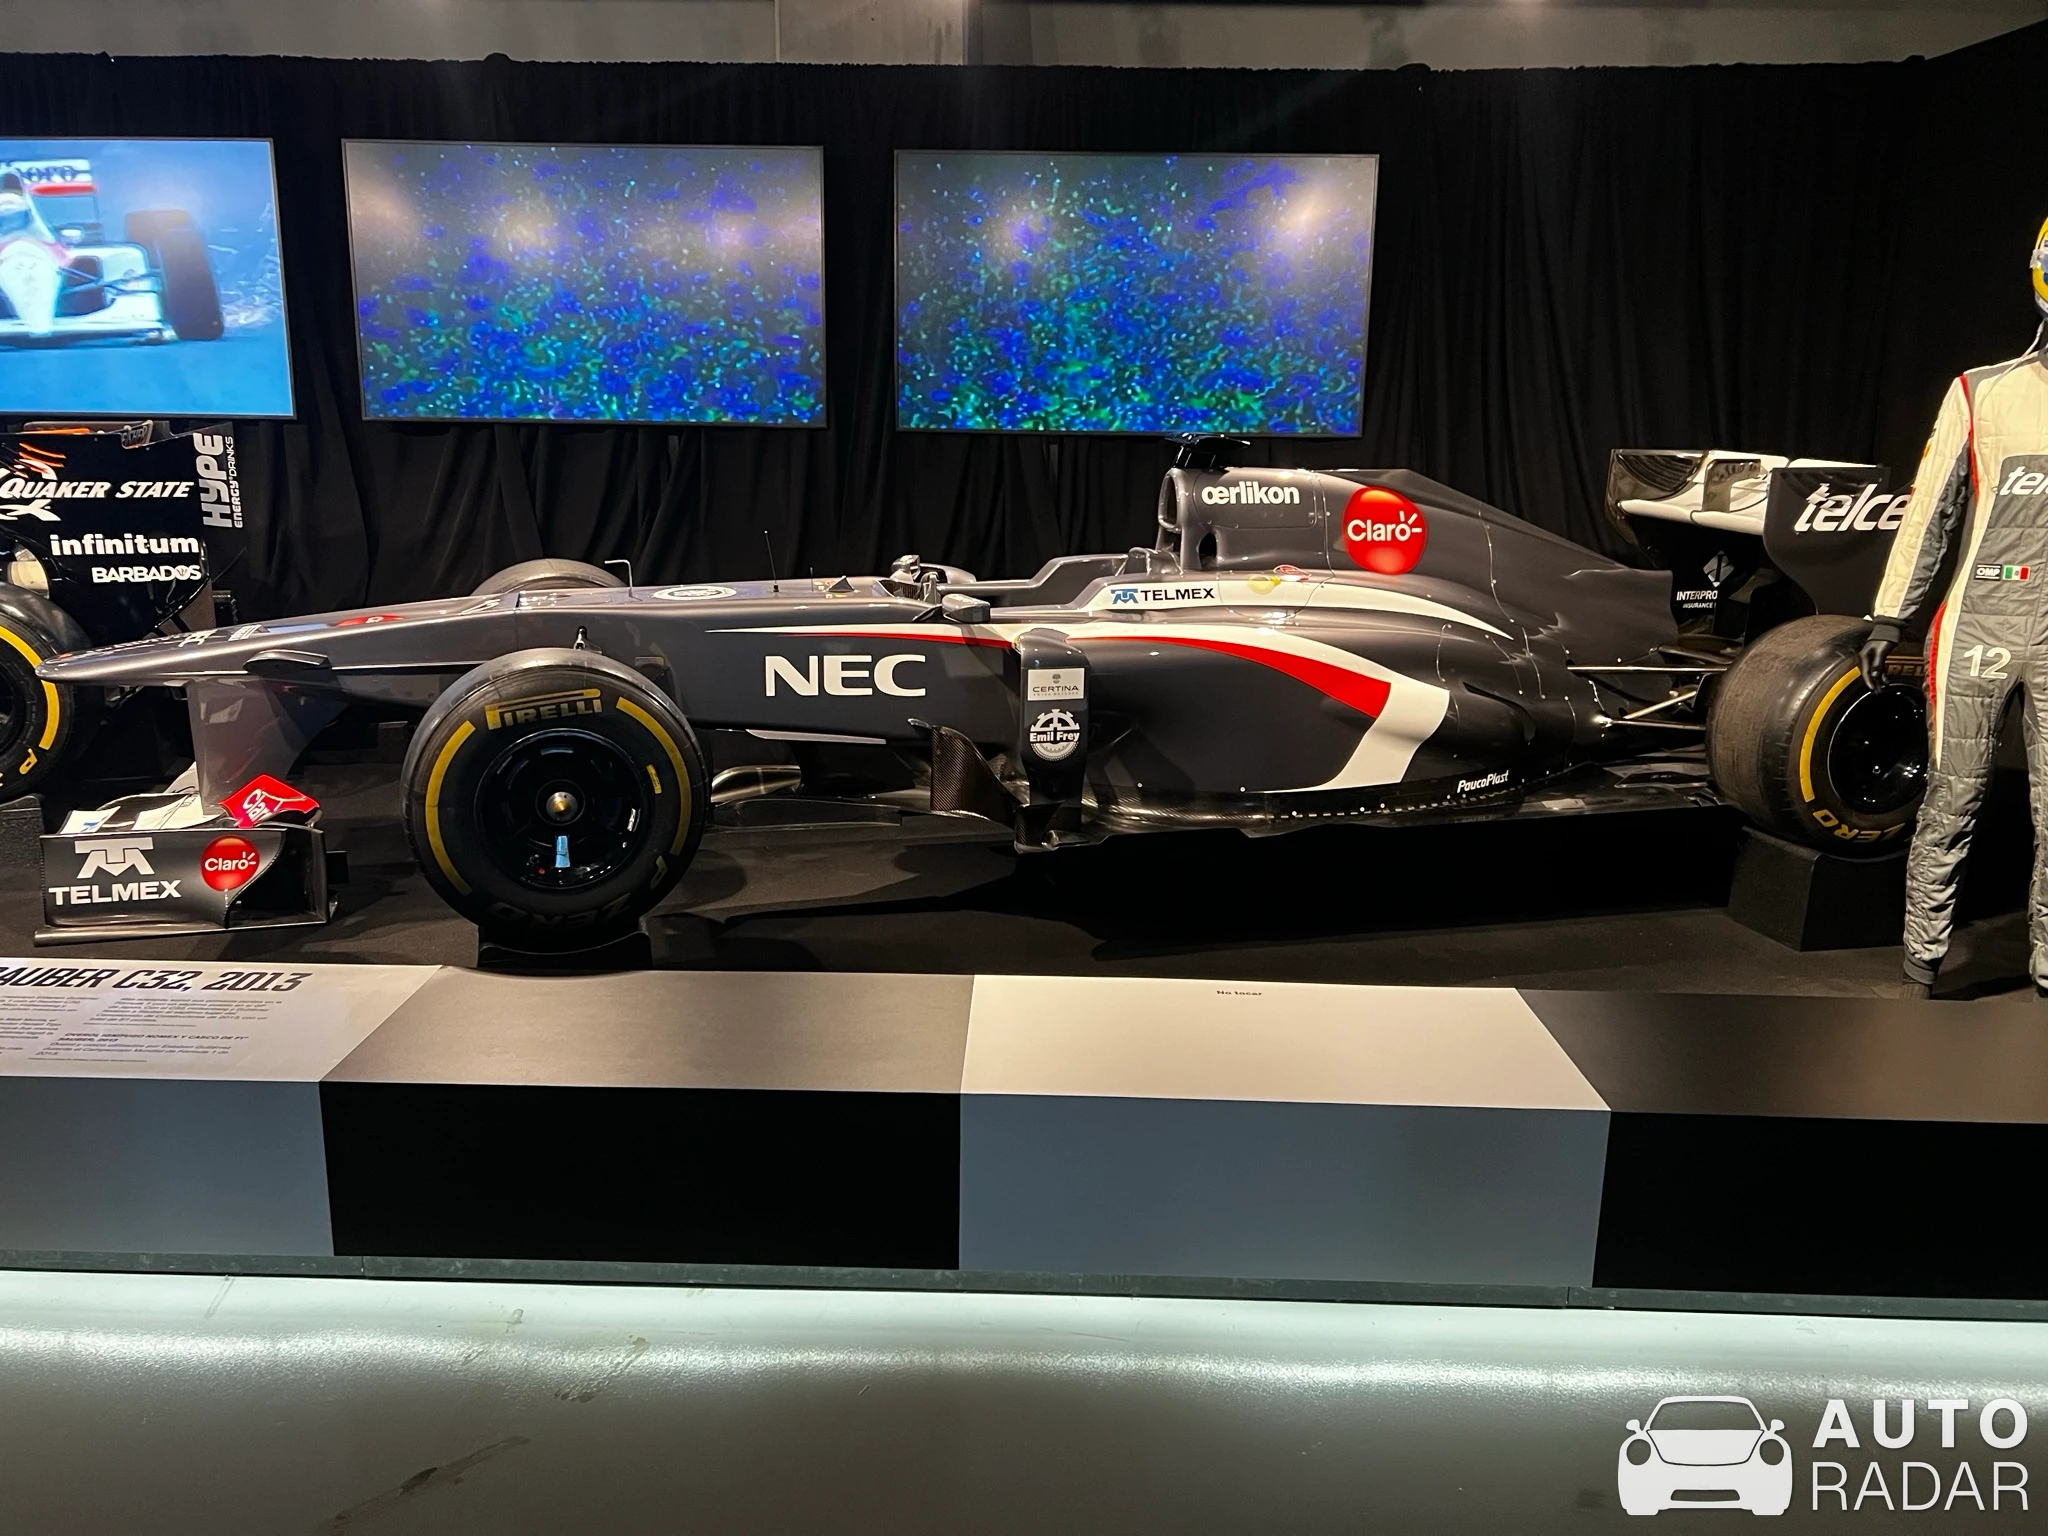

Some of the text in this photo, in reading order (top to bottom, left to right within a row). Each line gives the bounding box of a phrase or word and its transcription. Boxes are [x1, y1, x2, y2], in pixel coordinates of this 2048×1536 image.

[225, 436, 238, 477] DRINKS
[1, 478, 194, 498] QUAKER STATE
[1794, 484, 1911, 531] telce
[1347, 519, 1412, 542] Claro
[50, 533, 199, 555] infinitum
[92, 565, 201, 583] BARBADOS
[1976, 567, 2000, 577] OMP
[1141, 588, 1215, 602] TELMEX
[1676, 590, 1718, 600] INTERPRO
[1964, 645, 2012, 680] 12
[765, 655, 926, 697] NEC
[485, 688, 602, 730] PIRELLI
[1029, 730, 1080, 742] Emil Frey
[1456, 770, 1509, 793] PaucoPlast
[204, 856, 250, 872] Claro
[49, 880, 181, 905] TELMEX
[112, 969, 203, 992] C32,
[201, 971, 314, 992] 2013
